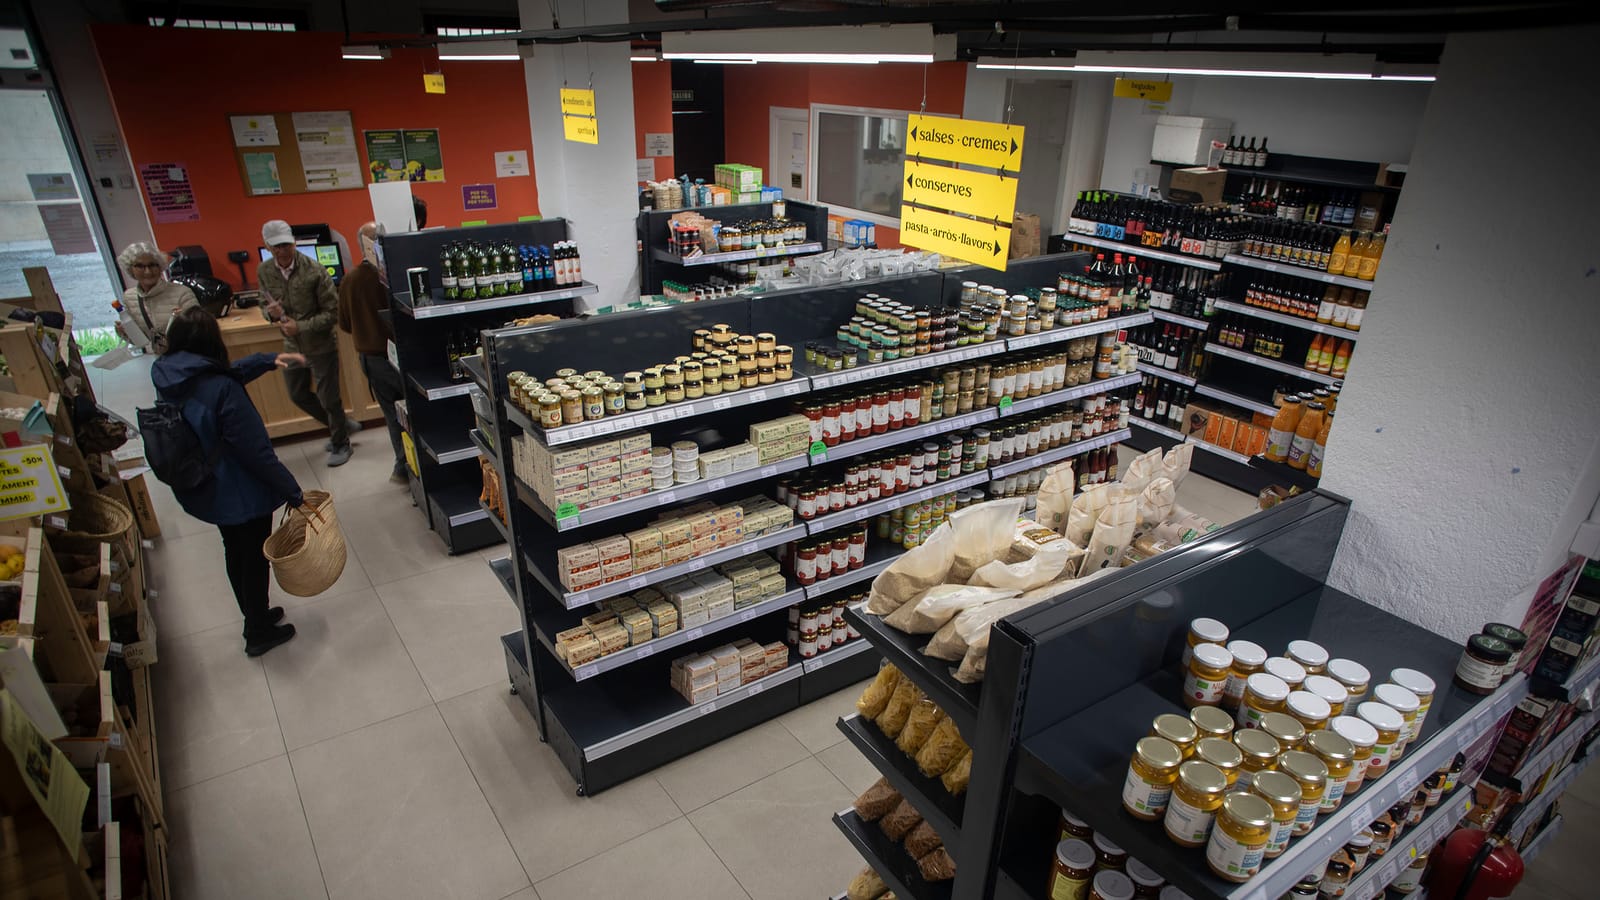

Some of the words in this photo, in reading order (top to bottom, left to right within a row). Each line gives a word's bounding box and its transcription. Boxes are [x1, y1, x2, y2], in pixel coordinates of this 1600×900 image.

[919, 128, 954, 144] salses
[962, 135, 1008, 152] cremes
[914, 177, 972, 197] conserves
[905, 221, 929, 235] pasta
[932, 227, 957, 242] arròs
[960, 232, 993, 252] llavors
